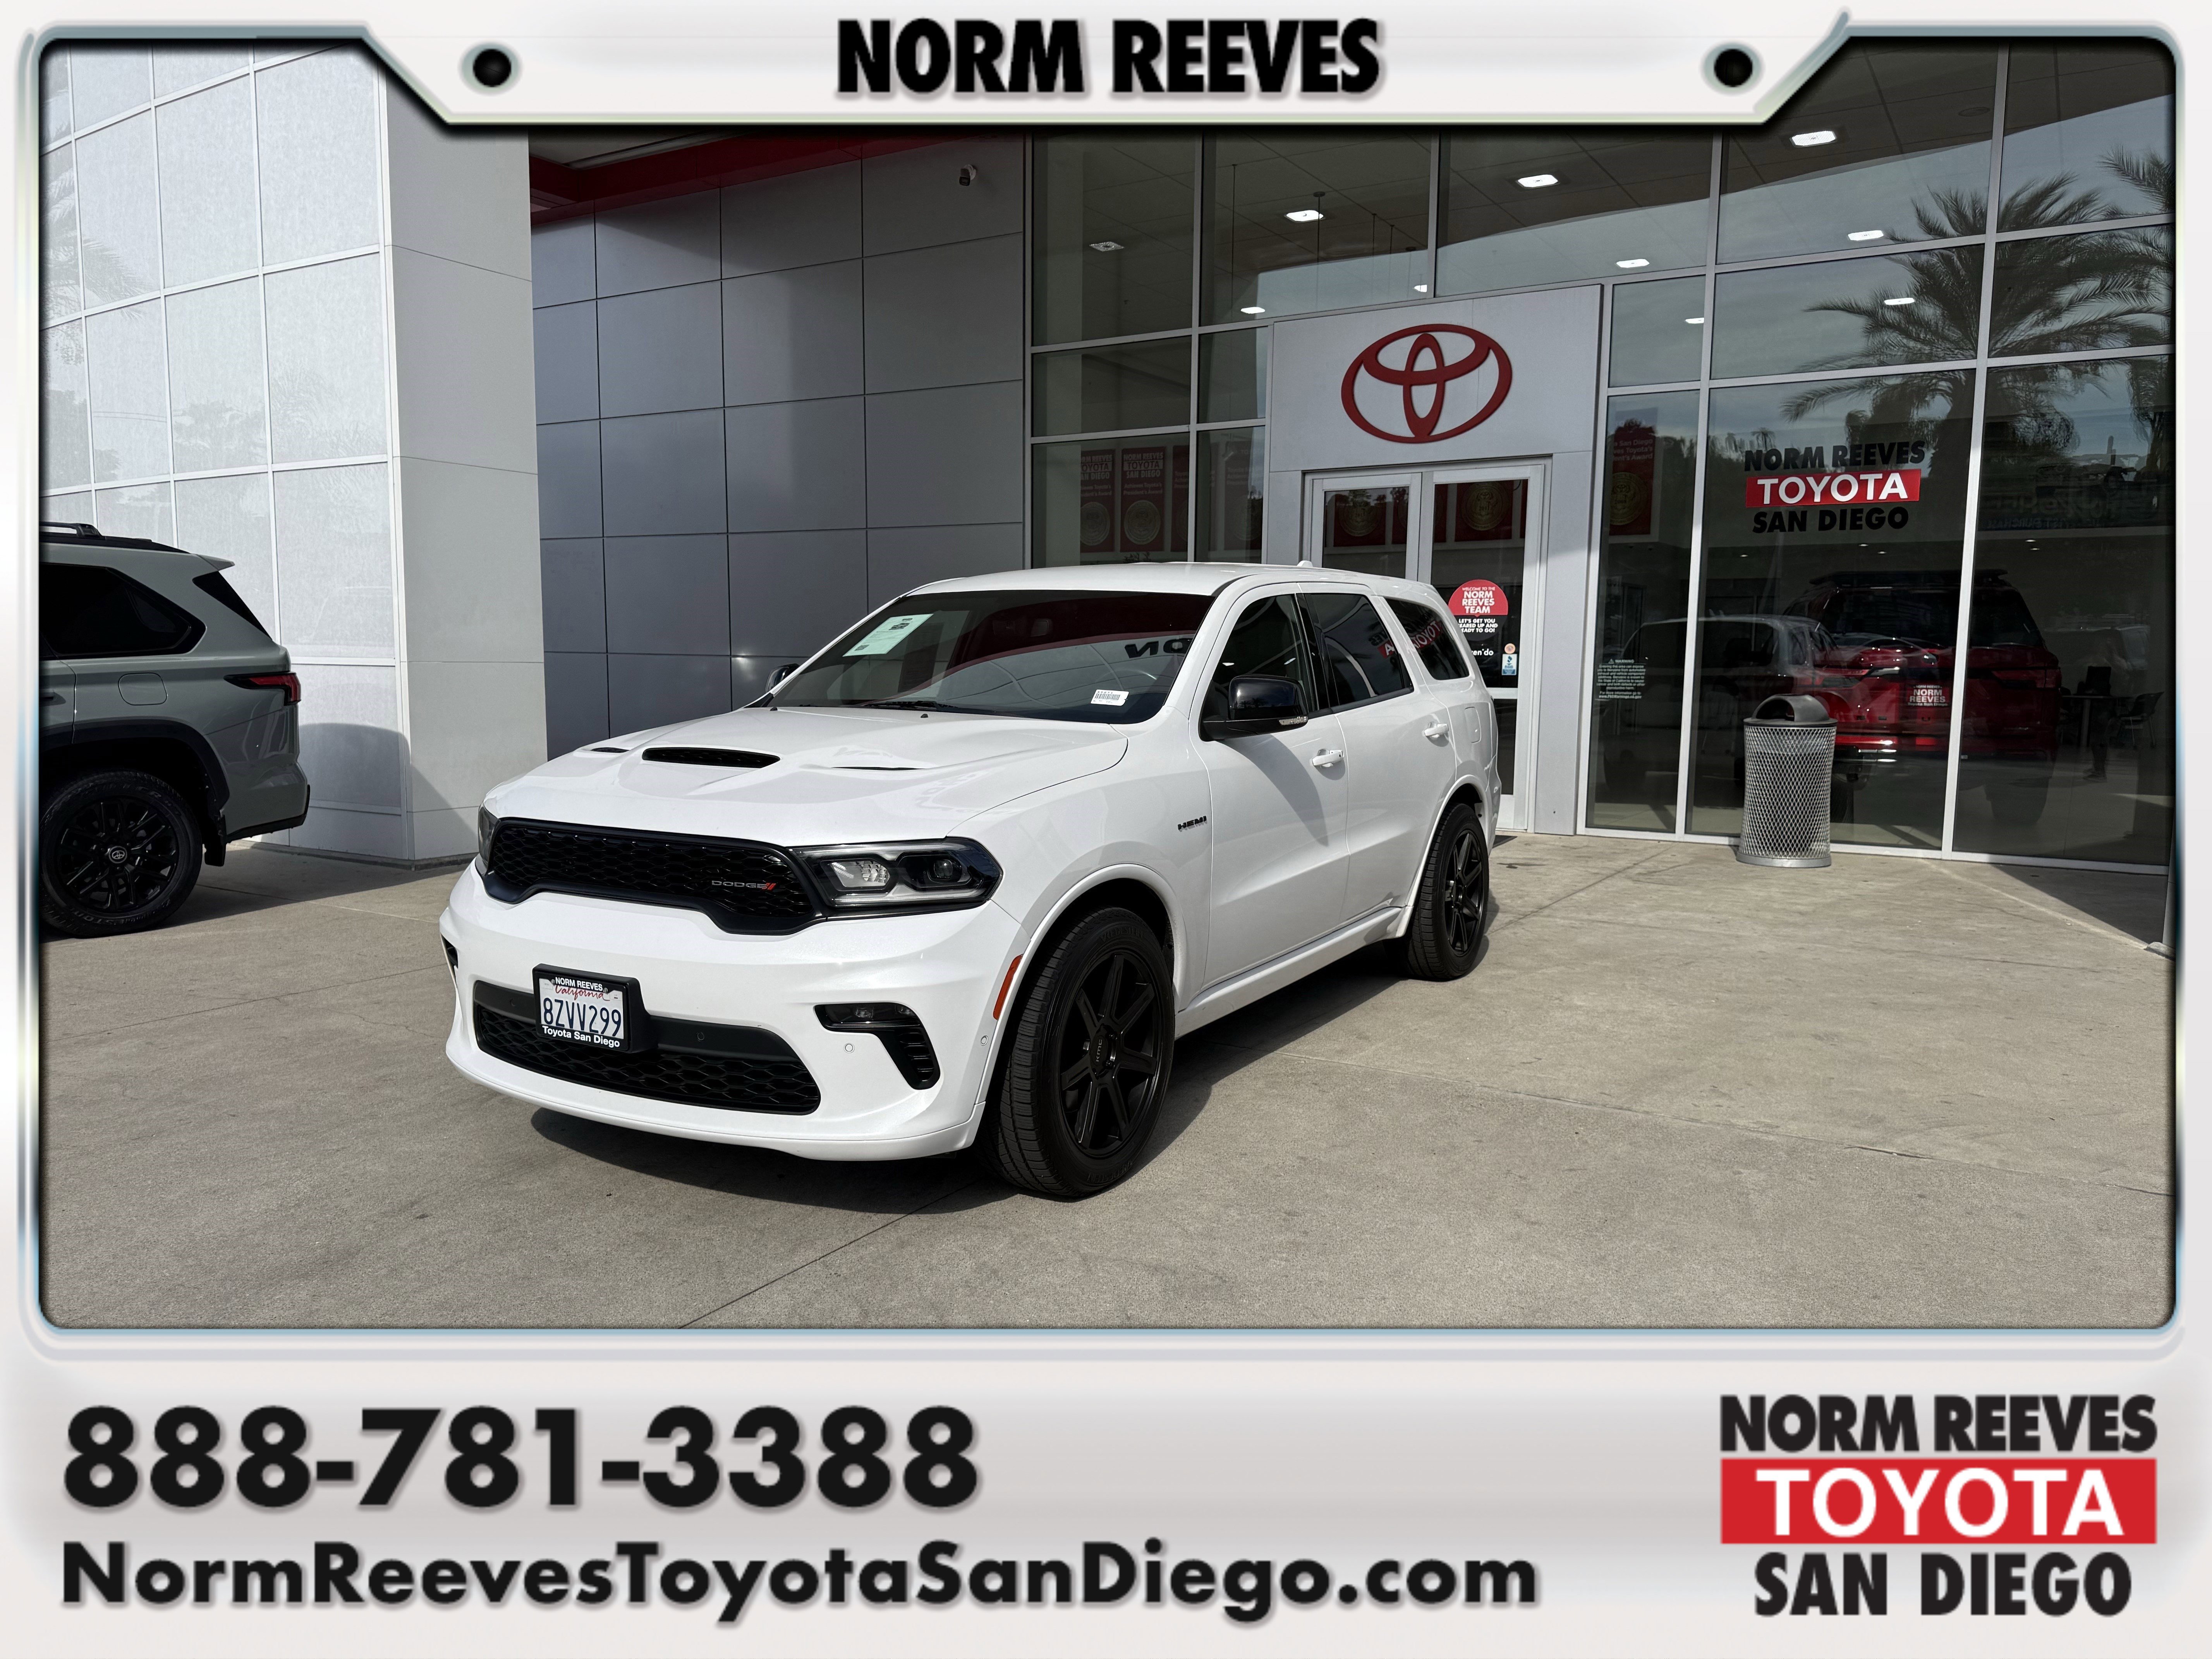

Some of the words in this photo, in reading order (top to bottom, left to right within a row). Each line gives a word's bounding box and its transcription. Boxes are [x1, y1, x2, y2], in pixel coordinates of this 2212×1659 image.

[1744, 447, 1825, 471] NORM
[1832, 441, 1925, 467] REEVES
[1081, 463, 1109, 471] OYOTA
[1757, 473, 1908, 504] TOYOTA
[1753, 510, 1808, 534] SAN
[1818, 507, 1908, 531] DIEGO
[1178, 815, 1207, 831] HEMI
[711, 880, 768, 889] DODGE
[555, 977, 576, 987] NORM
[577, 980, 603, 991] REEVES
[555, 985, 610, 1001] California
[543, 997, 622, 1037] 8ZVV299
[542, 1025, 572, 1039] Toyota
[574, 1031, 591, 1042] San
[594, 1034, 620, 1048] Diego
